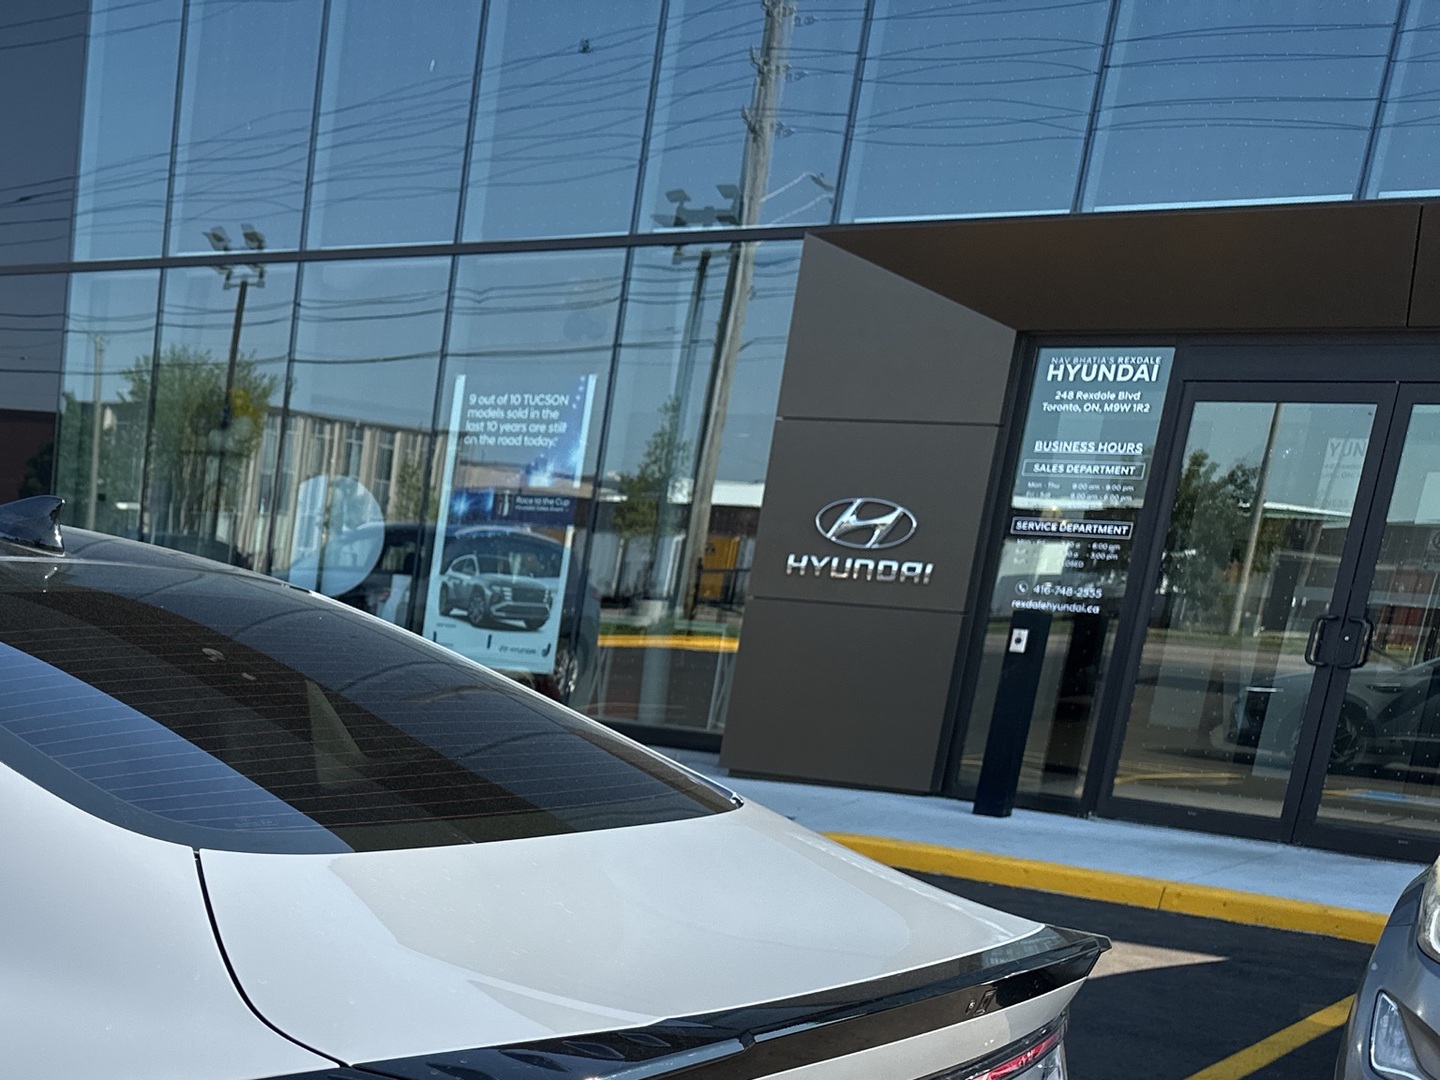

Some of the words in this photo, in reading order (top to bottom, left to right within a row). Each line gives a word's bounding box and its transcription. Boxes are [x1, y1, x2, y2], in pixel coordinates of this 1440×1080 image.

[1117, 356, 1162, 364] REXDALE
[1047, 364, 1160, 382] HYUNDAI
[468, 393, 477, 405] 9
[478, 394, 496, 406] out
[496, 393, 509, 405] of
[510, 393, 521, 405] 10
[523, 393, 569, 406] TUCSON
[1054, 390, 1074, 400] 248
[1076, 390, 1116, 400] Rexdale
[1118, 391, 1142, 401] Blvd
[467, 407, 505, 419] models
[506, 407, 529, 419] sold
[530, 407, 540, 419] in
[541, 408, 560, 420] the
[1042, 402, 1082, 413] Toronto,
[1083, 403, 1102, 413] ON,
[1103, 403, 1132, 413] M9W
[1133, 403, 1150, 413] 1R2
[465, 420, 484, 432] last
[486, 421, 498, 432] 10
[499, 422, 527, 434] years
[528, 423, 547, 433] are
[548, 421, 568, 433] still
[463, 436, 478, 445] on
[479, 434, 496, 445] the
[497, 435, 523, 446] road
[1034, 440, 1095, 452] BUSINESS
[1098, 442, 1144, 455] HOURS
[1033, 463, 1064, 474] SALES
[1066, 464, 1136, 476] DEPARTMENT
[1015, 520, 1057, 532] SERVICE
[1059, 522, 1129, 535] DEPARTMENT
[786, 553, 935, 584] HYUNDAI
[1011, 600, 1100, 614] rexdalehyundai.ca
